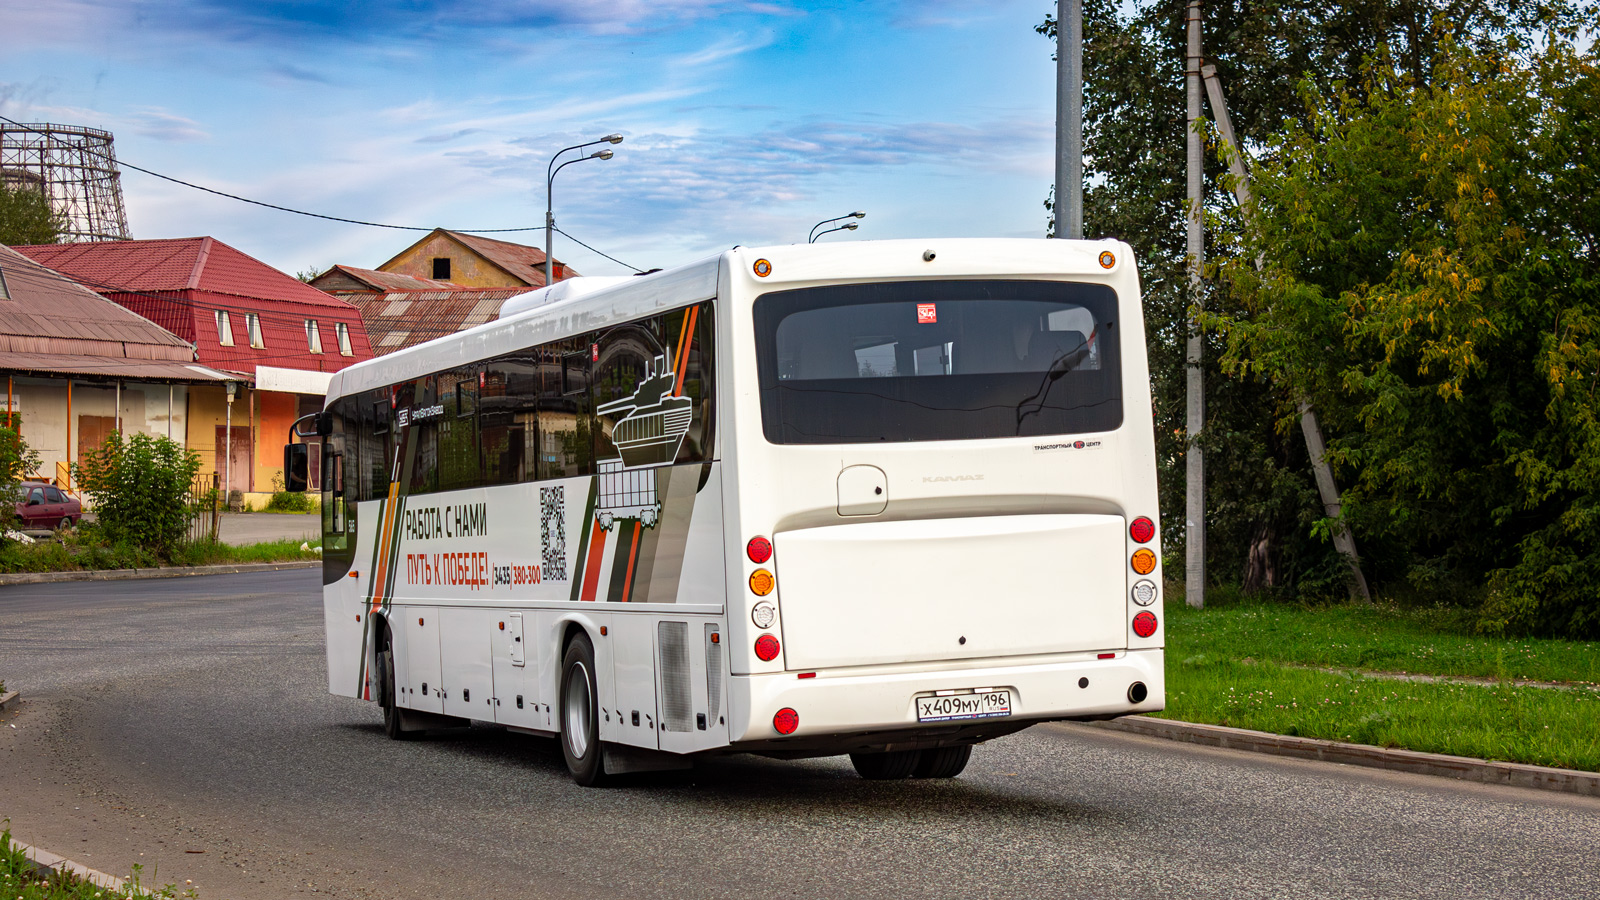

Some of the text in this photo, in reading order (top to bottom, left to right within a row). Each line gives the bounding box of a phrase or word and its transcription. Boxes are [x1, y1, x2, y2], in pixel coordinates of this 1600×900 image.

[406, 503, 487, 540] РАБОТА С НАМИ
[407, 552, 488, 591] ПУТЬ К ПОБЕДЕ!
[984, 693, 1006, 707] 196
